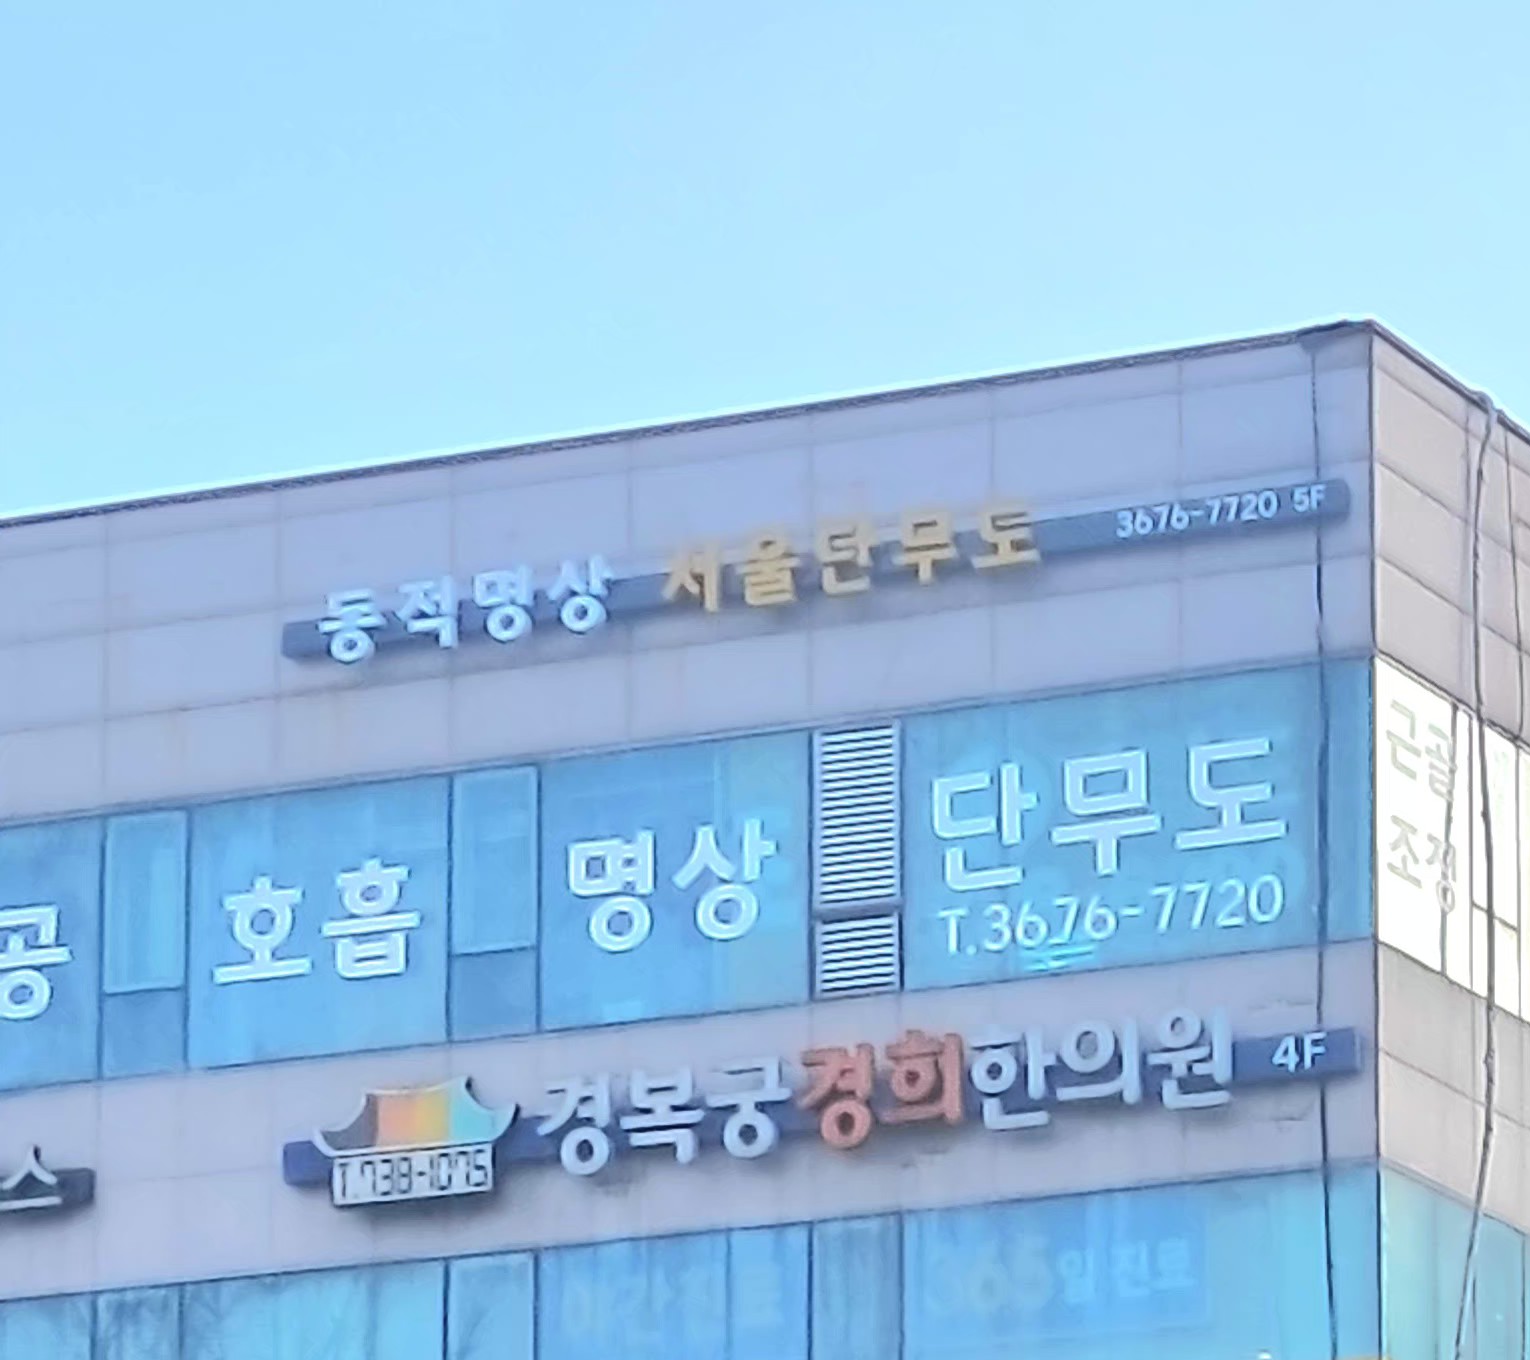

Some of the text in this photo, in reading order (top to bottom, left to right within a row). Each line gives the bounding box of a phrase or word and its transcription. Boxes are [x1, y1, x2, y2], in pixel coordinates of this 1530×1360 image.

[318, 483, 1327, 662] 동적명상 서울단무도 3676-7720 5F
[212, 856, 422, 986] 호흡
[566, 817, 780, 955] 명상
[930, 736, 1290, 894] 단무도
[937, 872, 1287, 959] T.3676-7720
[1271, 1030, 1328, 1074] 4F
